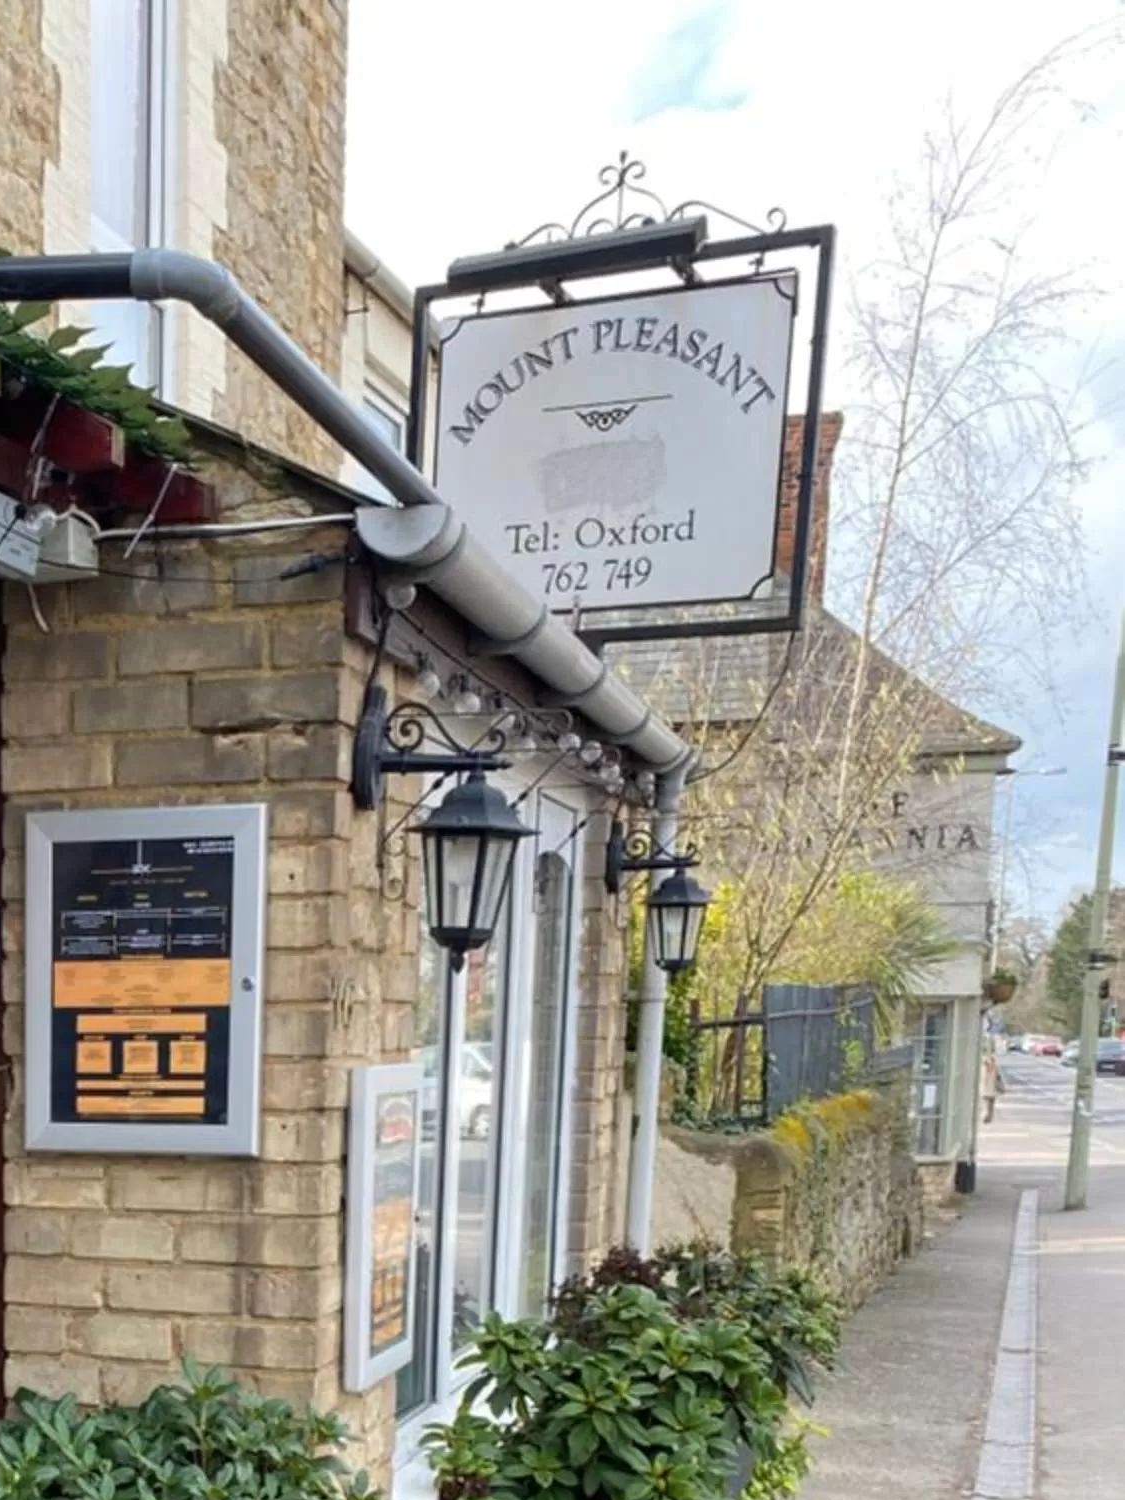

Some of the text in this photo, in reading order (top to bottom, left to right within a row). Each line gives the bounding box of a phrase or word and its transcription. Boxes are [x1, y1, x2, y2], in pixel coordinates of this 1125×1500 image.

[448, 316, 777, 447] MOUNT PLEASANT
[505, 509, 697, 556] Tel: Oxford
[542, 556, 653, 594] 762 749
